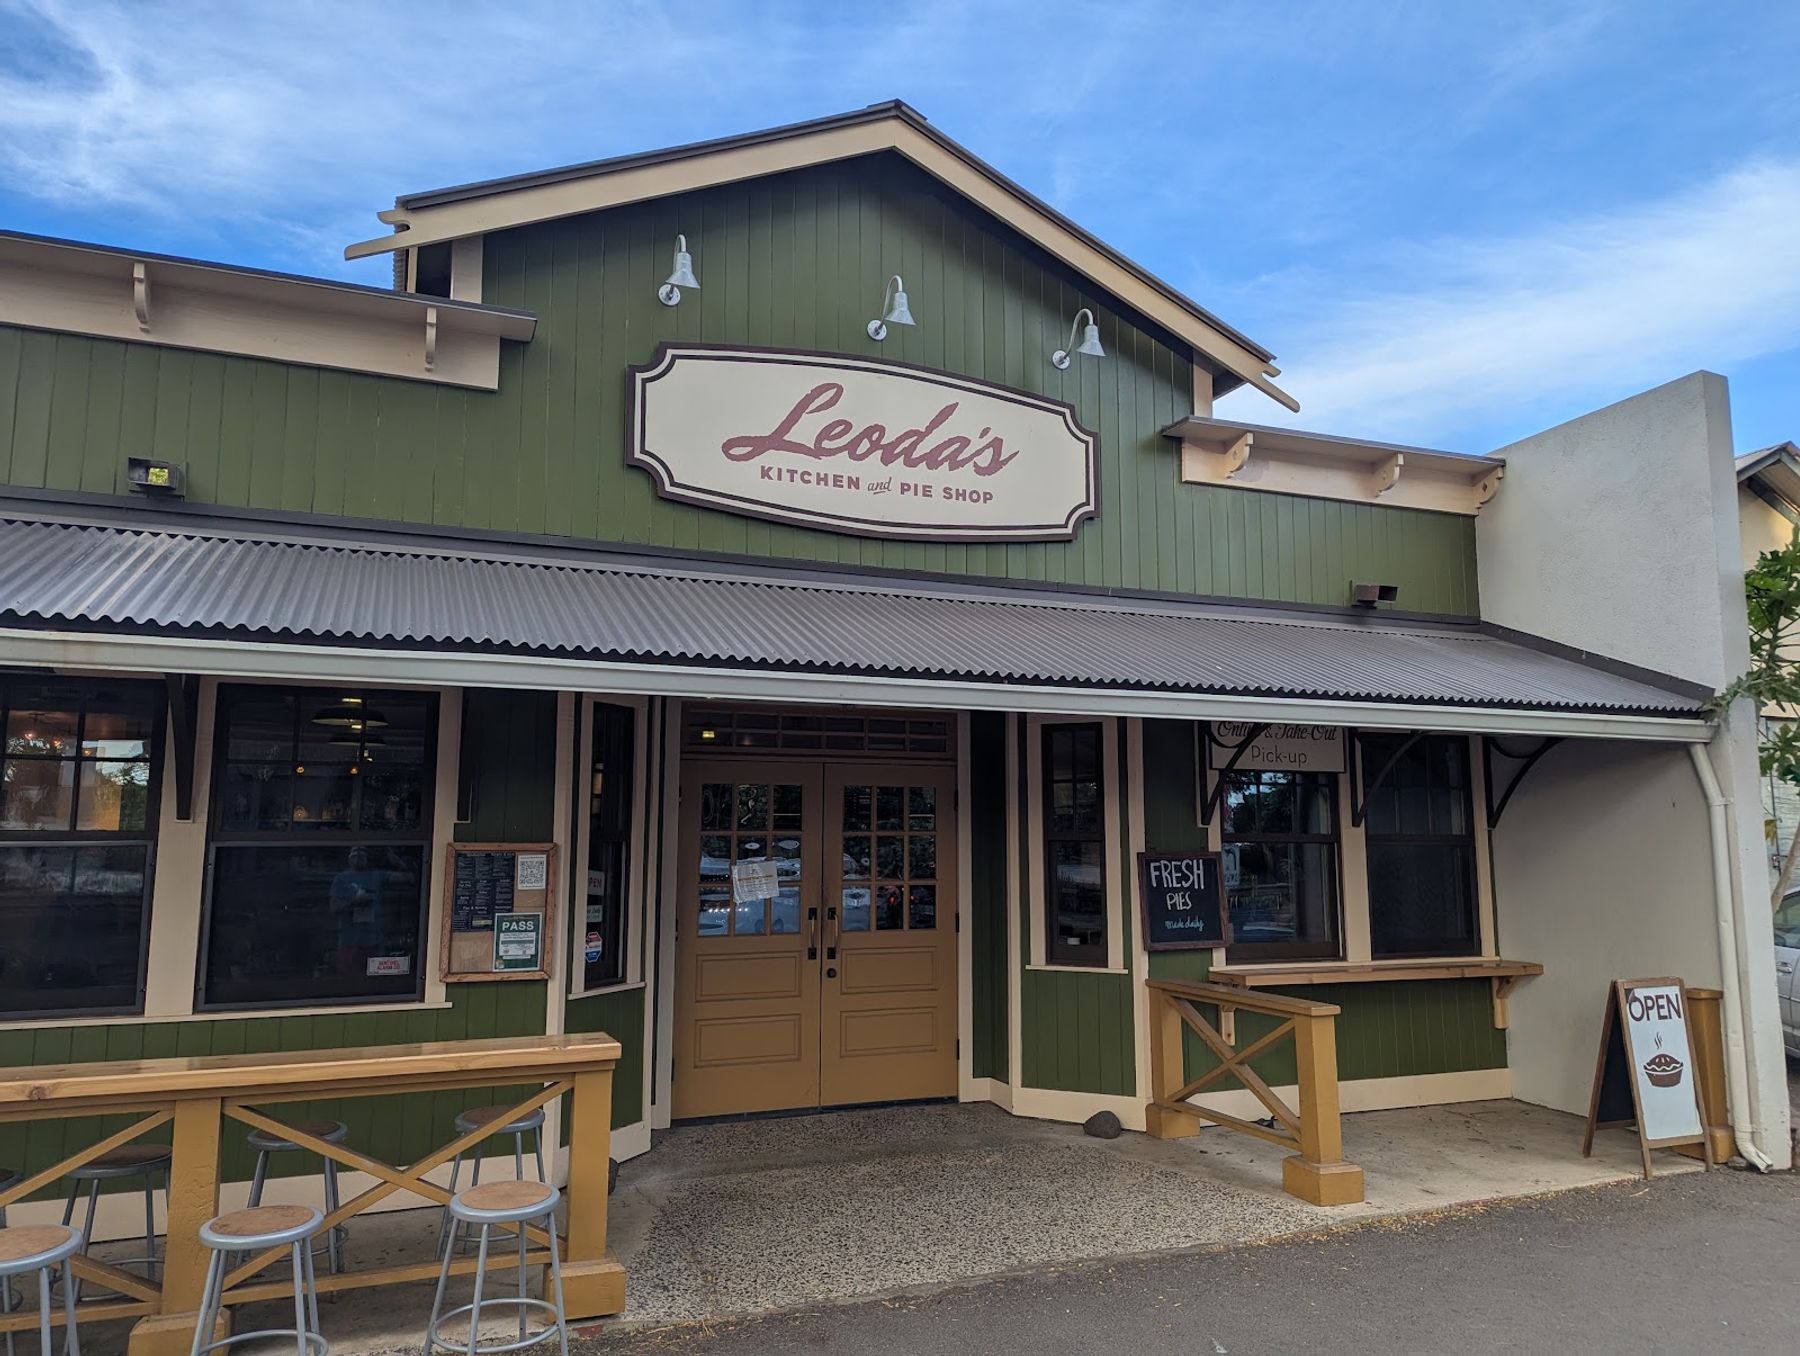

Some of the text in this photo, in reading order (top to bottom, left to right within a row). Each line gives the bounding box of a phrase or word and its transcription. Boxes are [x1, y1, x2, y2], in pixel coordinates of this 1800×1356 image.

[722, 382, 1019, 476] Leoda's
[760, 465, 994, 504] KITCHEN and PIE SHOP
[1264, 727, 1274, 738] &
[1251, 745, 1308, 768] Pick-up
[588, 877, 601, 889] PEN
[1150, 859, 1205, 889] FRESH
[1166, 892, 1192, 911] PIES
[502, 921, 534, 931] PASS
[1629, 993, 1681, 1021] OPEN
